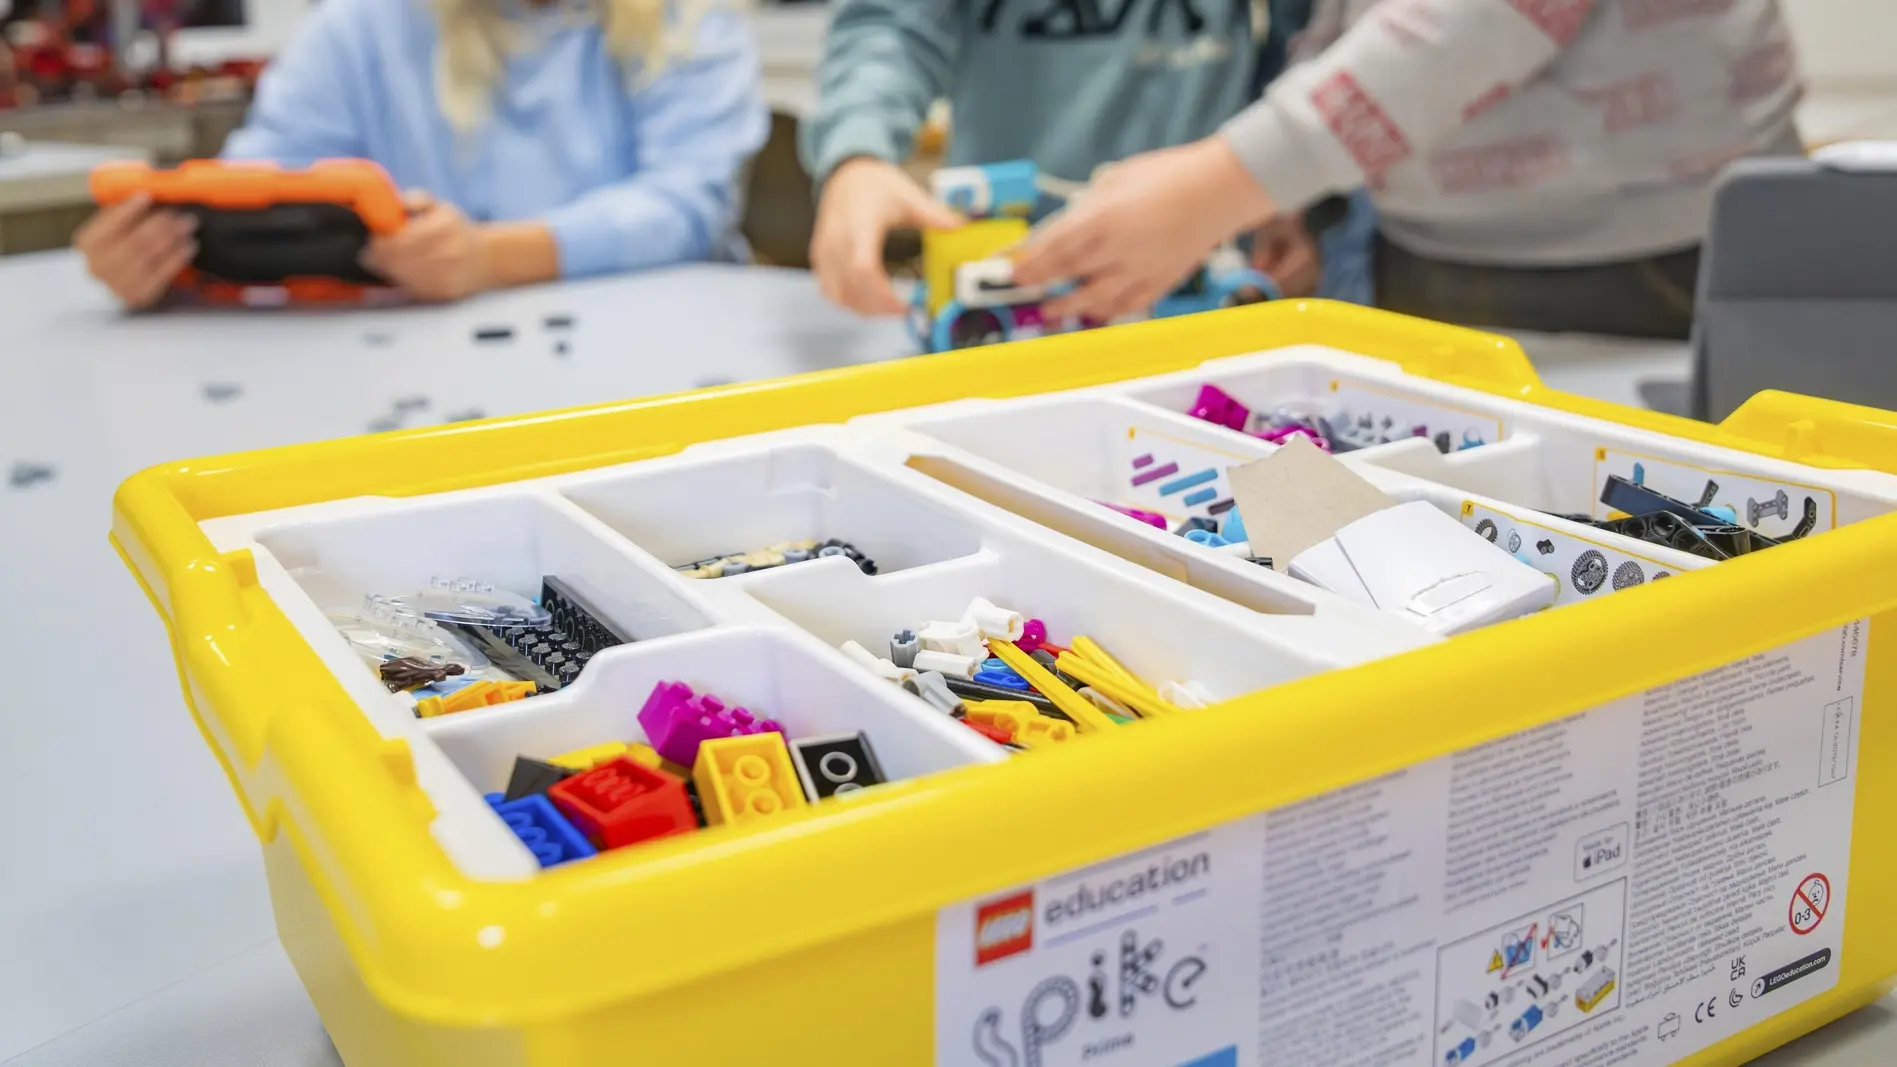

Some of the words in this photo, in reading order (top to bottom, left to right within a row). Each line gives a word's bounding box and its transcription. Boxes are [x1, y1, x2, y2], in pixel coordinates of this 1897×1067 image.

[1594, 842, 1620, 865] iPad
[1044, 851, 1210, 926] education
[1794, 908, 1811, 925] 0-3
[1731, 955, 1747, 970] UK
[1769, 955, 1826, 986] LEGOeducation.com
[1730, 967, 1746, 981] CA
